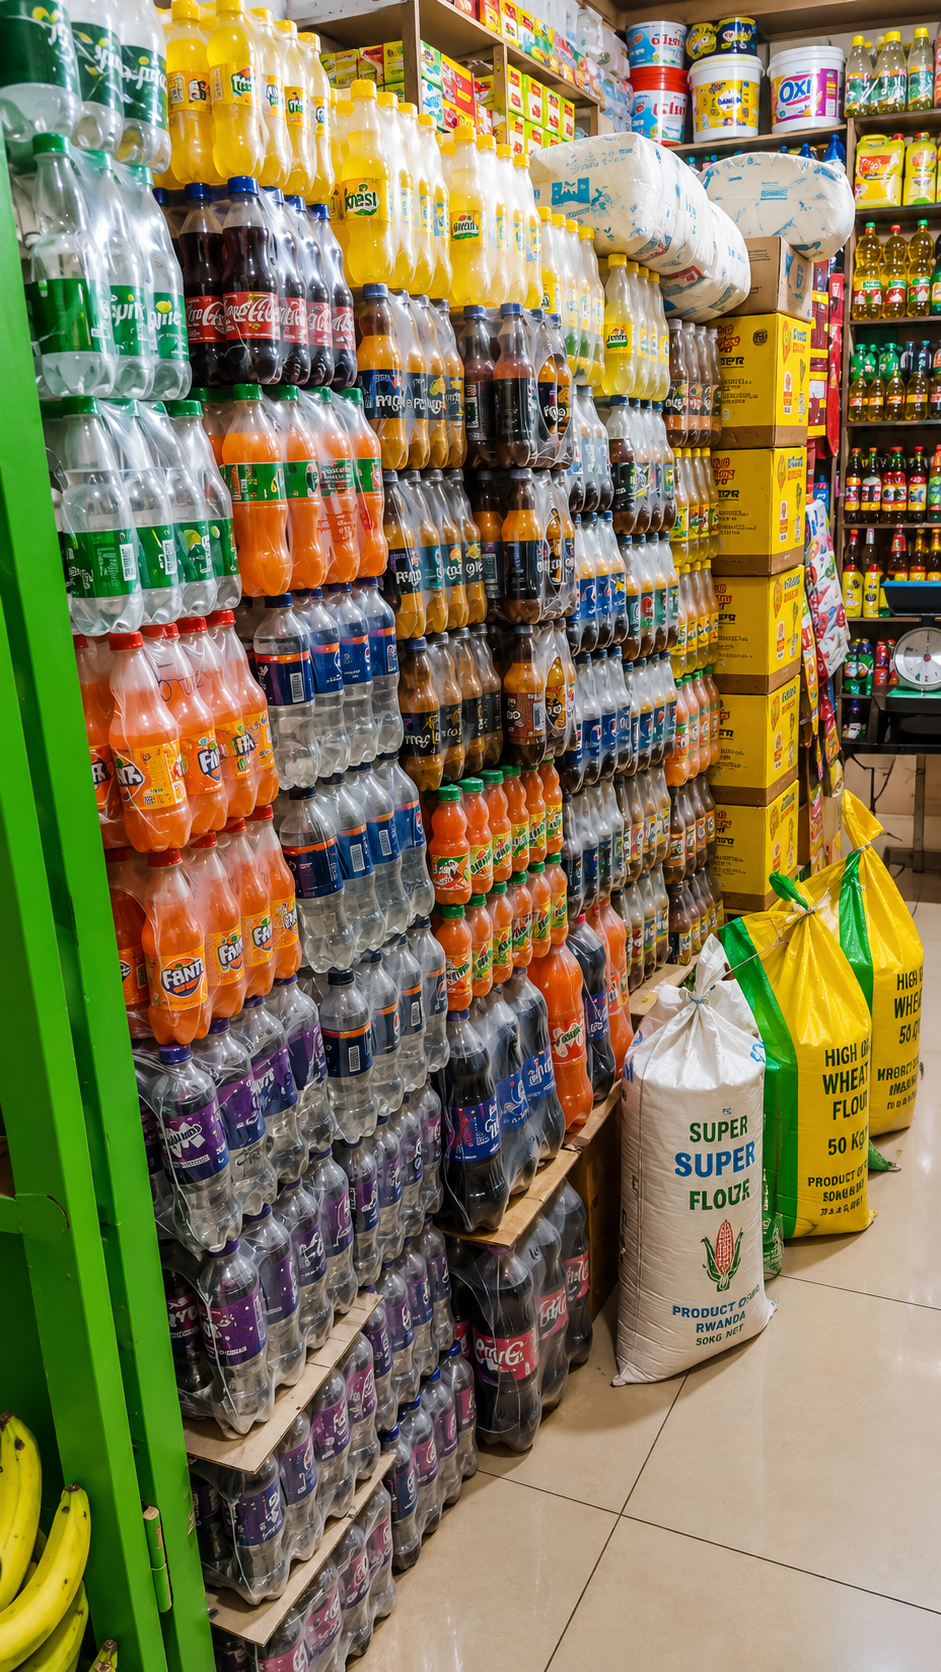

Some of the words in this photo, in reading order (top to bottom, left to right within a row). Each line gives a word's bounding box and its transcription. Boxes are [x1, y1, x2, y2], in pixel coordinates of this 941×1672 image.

[779, 76, 812, 103] OXI
[825, 1043, 858, 1067] HIGH
[689, 1115, 748, 1143] SUPER
[828, 1136, 847, 1155] 50
[674, 1141, 756, 1178] SUPER
[808, 1171, 855, 1187] PRODUCT
[672, 1301, 737, 1318] PRODUCT
[696, 1310, 746, 1333] RWANDA
[725, 1323, 744, 1338] NET
